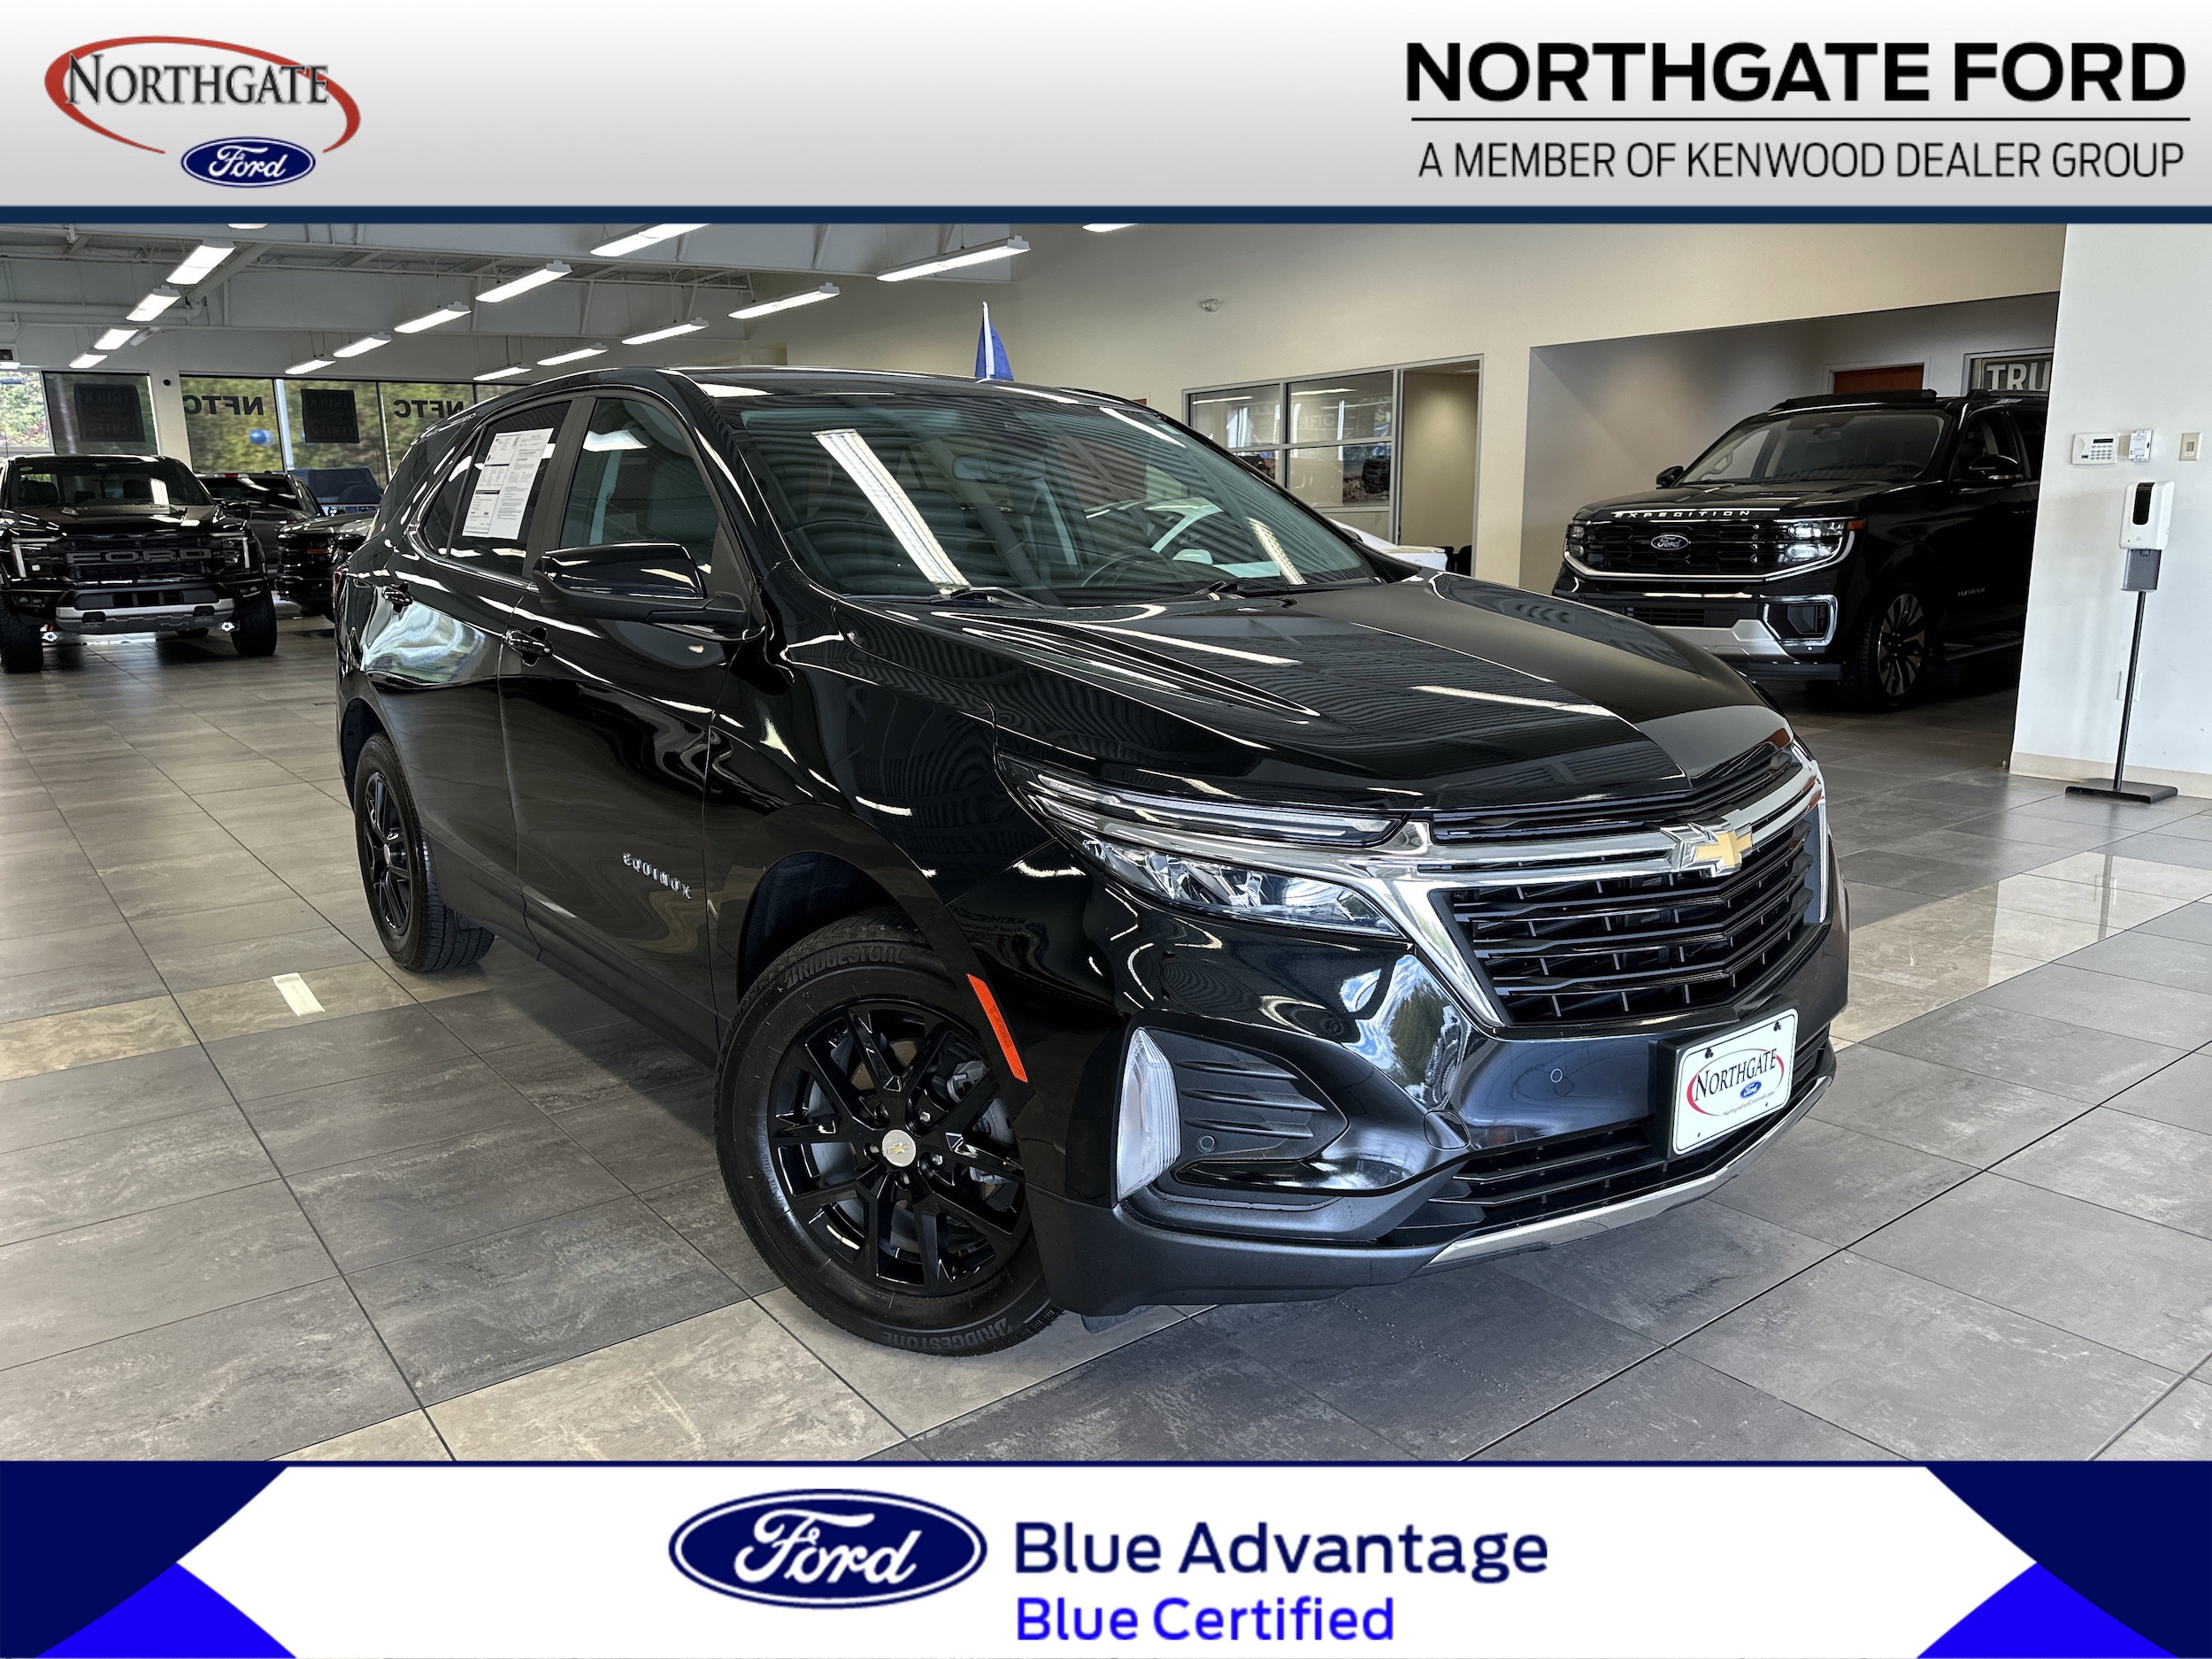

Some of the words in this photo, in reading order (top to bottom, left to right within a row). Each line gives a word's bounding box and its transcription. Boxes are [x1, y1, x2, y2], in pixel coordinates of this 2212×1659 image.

[1613, 510, 1750, 518] EXPEDITION
[66, 549, 211, 565] FORD
[622, 852, 692, 900] EQUINOX
[785, 945, 909, 989] BRIDGESTONE
[1694, 1048, 1778, 1102] NORTHGATE
[883, 1317, 1014, 1350] BRIDGESTONE
